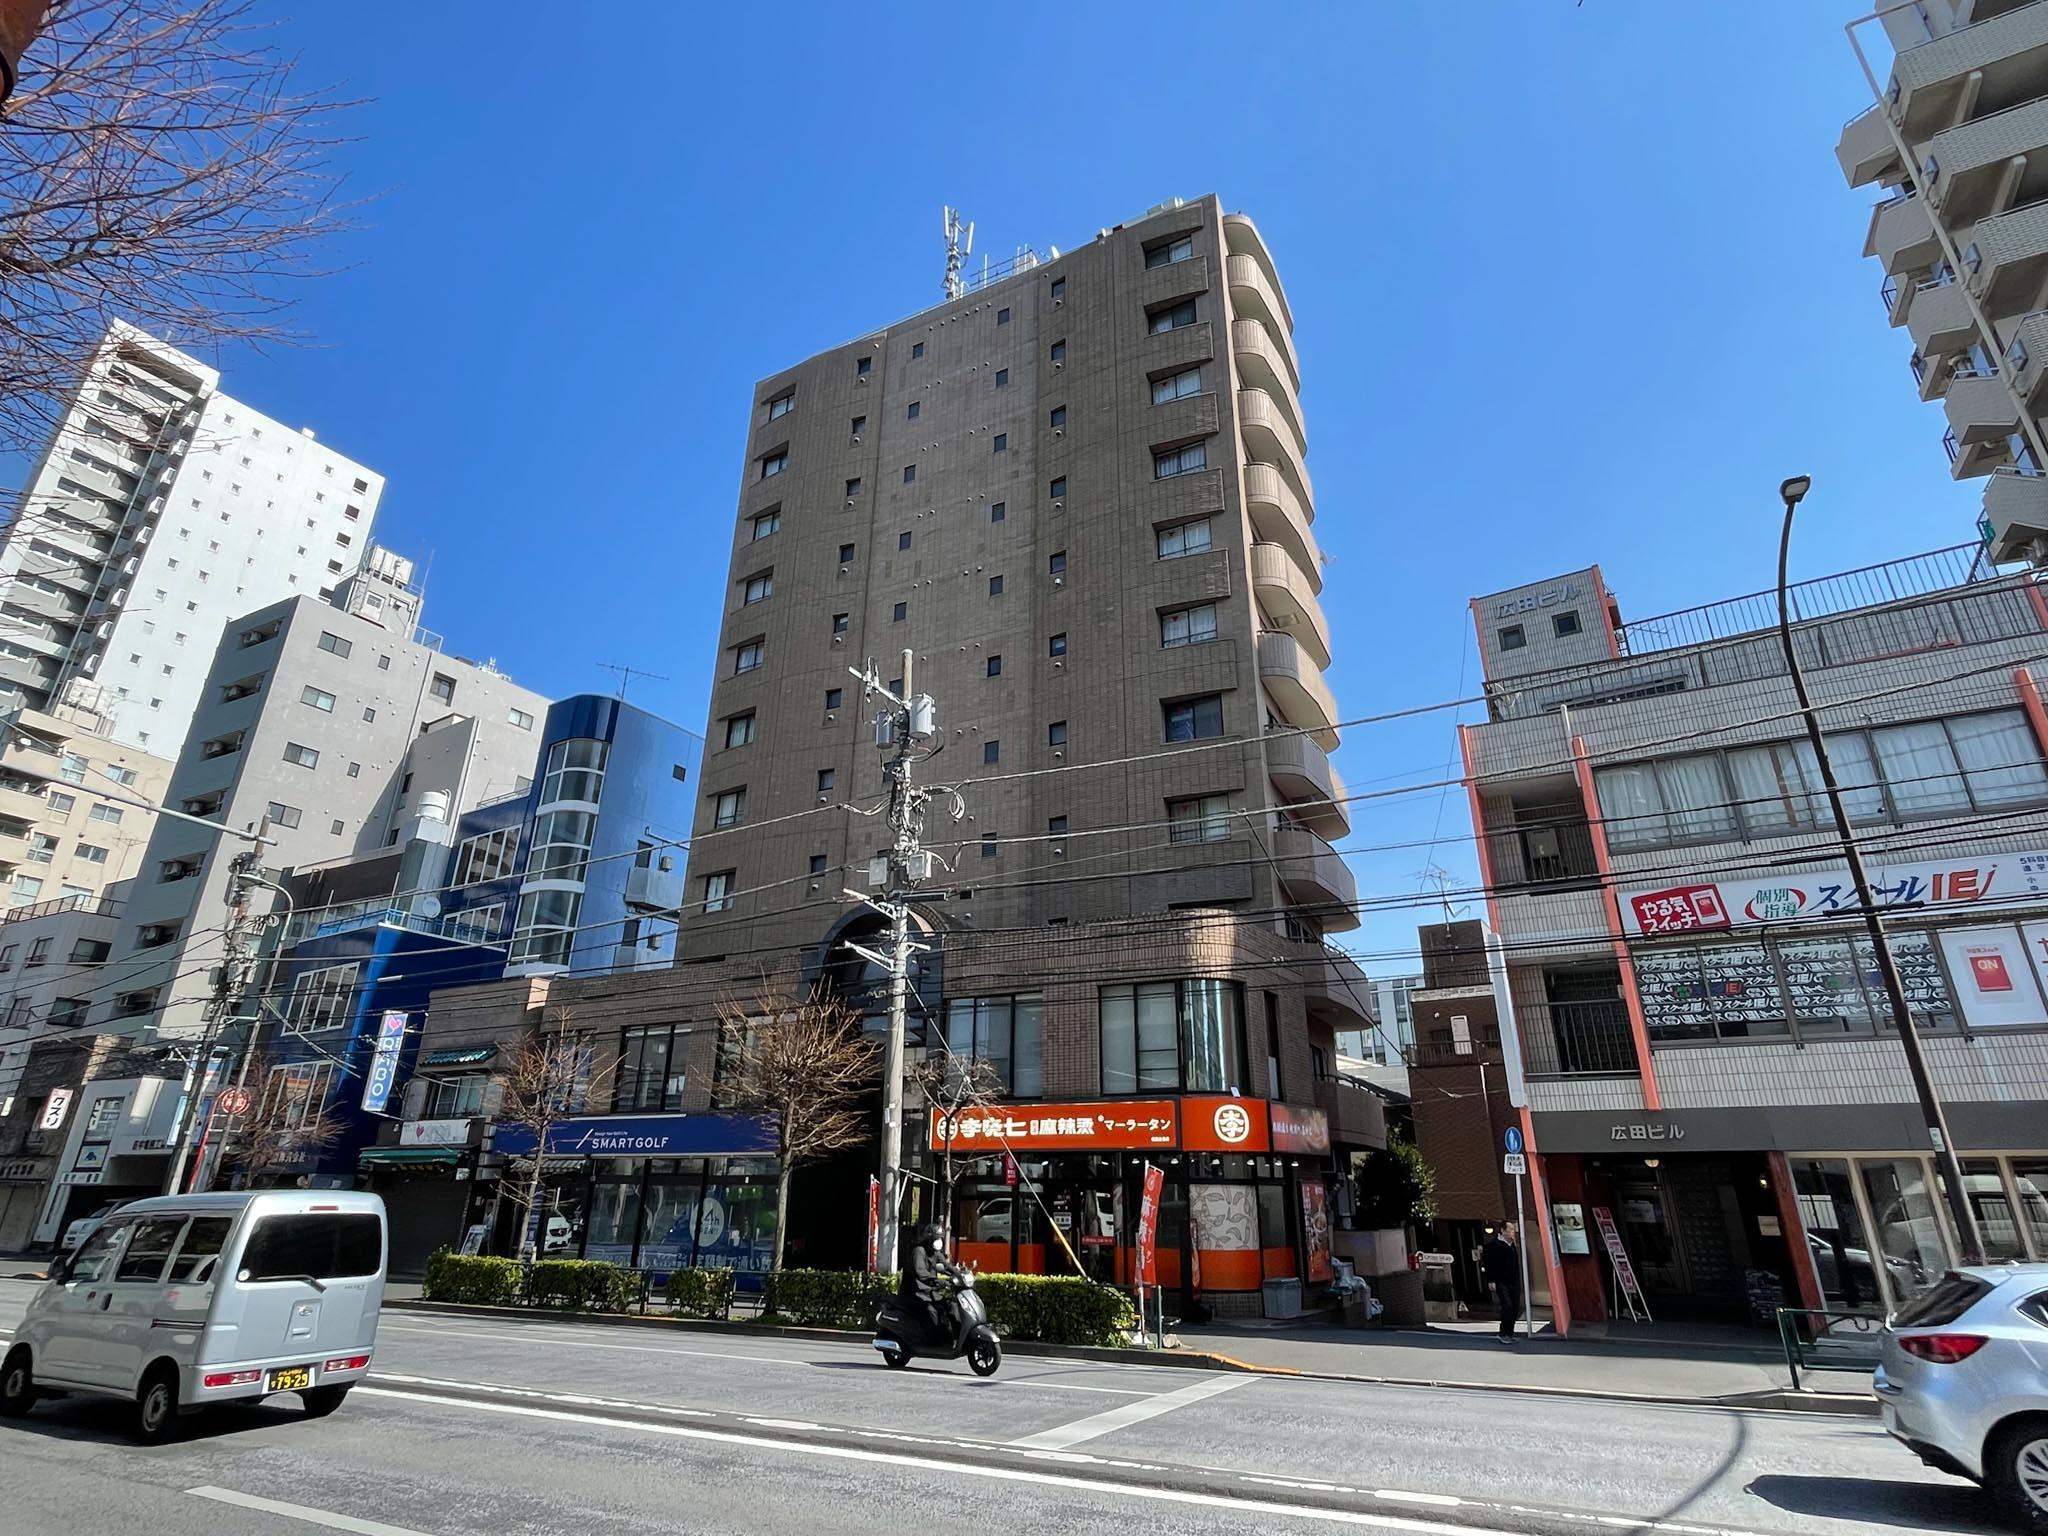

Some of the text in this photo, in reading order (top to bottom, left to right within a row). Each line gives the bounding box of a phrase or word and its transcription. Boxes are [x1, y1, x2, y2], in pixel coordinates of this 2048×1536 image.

[1496, 584, 1581, 619] 広田ビル
[1756, 888, 1789, 905] 個別
[1640, 896, 1690, 918] やる気
[1764, 904, 1799, 919] 指導
[1644, 911, 1697, 934] スイッチ
[1977, 959, 1999, 970] ON
[46, 1096, 66, 1127] クスリ
[1104, 1118, 1172, 1132] マーラータン
[1611, 1124, 1685, 1140] 広田ビル
[276, 1374, 308, 1391] 79-29
